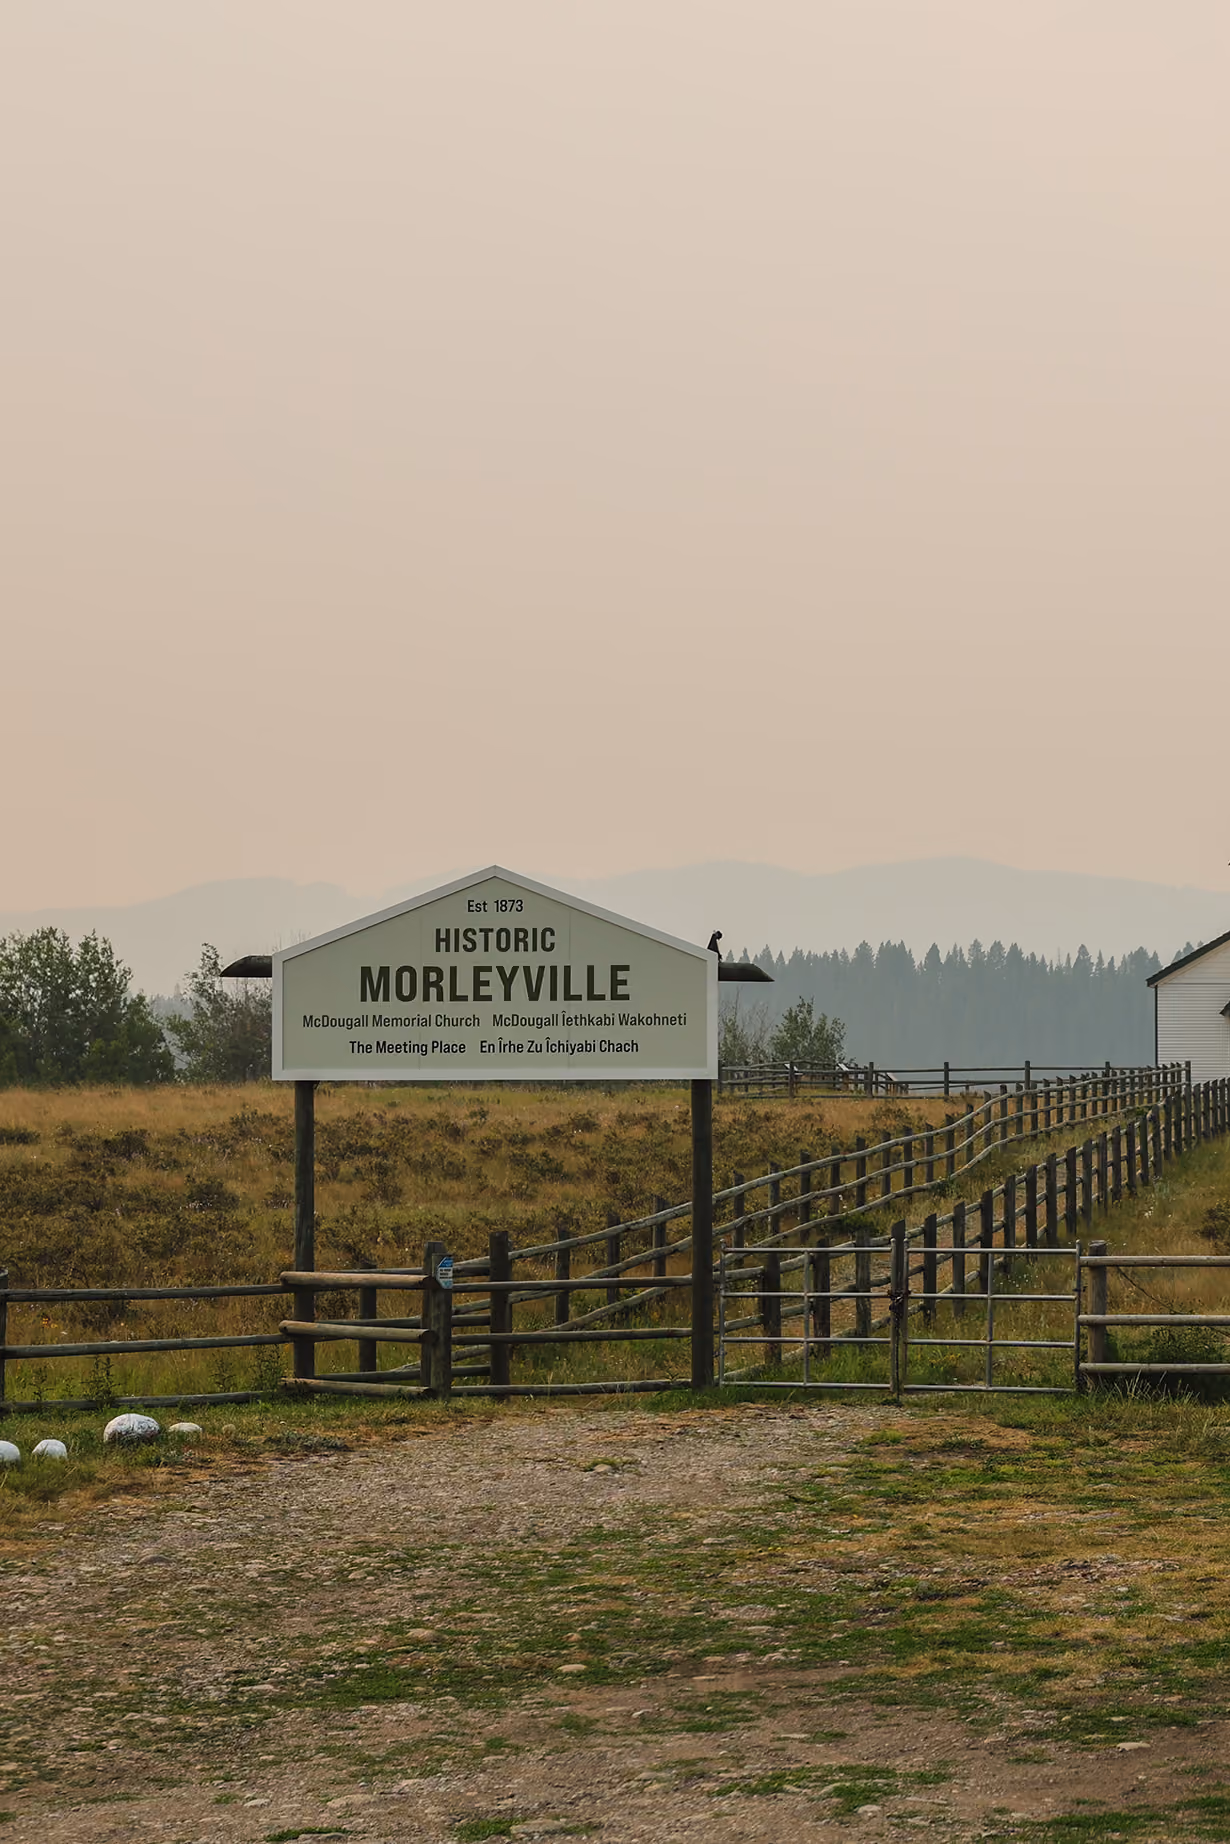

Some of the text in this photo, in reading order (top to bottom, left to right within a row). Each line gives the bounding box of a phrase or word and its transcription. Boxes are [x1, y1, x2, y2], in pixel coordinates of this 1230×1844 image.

[466, 900, 524, 913] Est 1873
[434, 927, 556, 953] HISTORIC
[359, 964, 631, 1003] MORLEYVILLE
[302, 1014, 480, 1030] McDougall Memorial Church
[492, 1010, 687, 1029] McDougall Îethkabi Wakohneti
[349, 1040, 467, 1056] The Meeting Place
[480, 1037, 639, 1056] En Îrhe Zu Îchiyabi Chach
